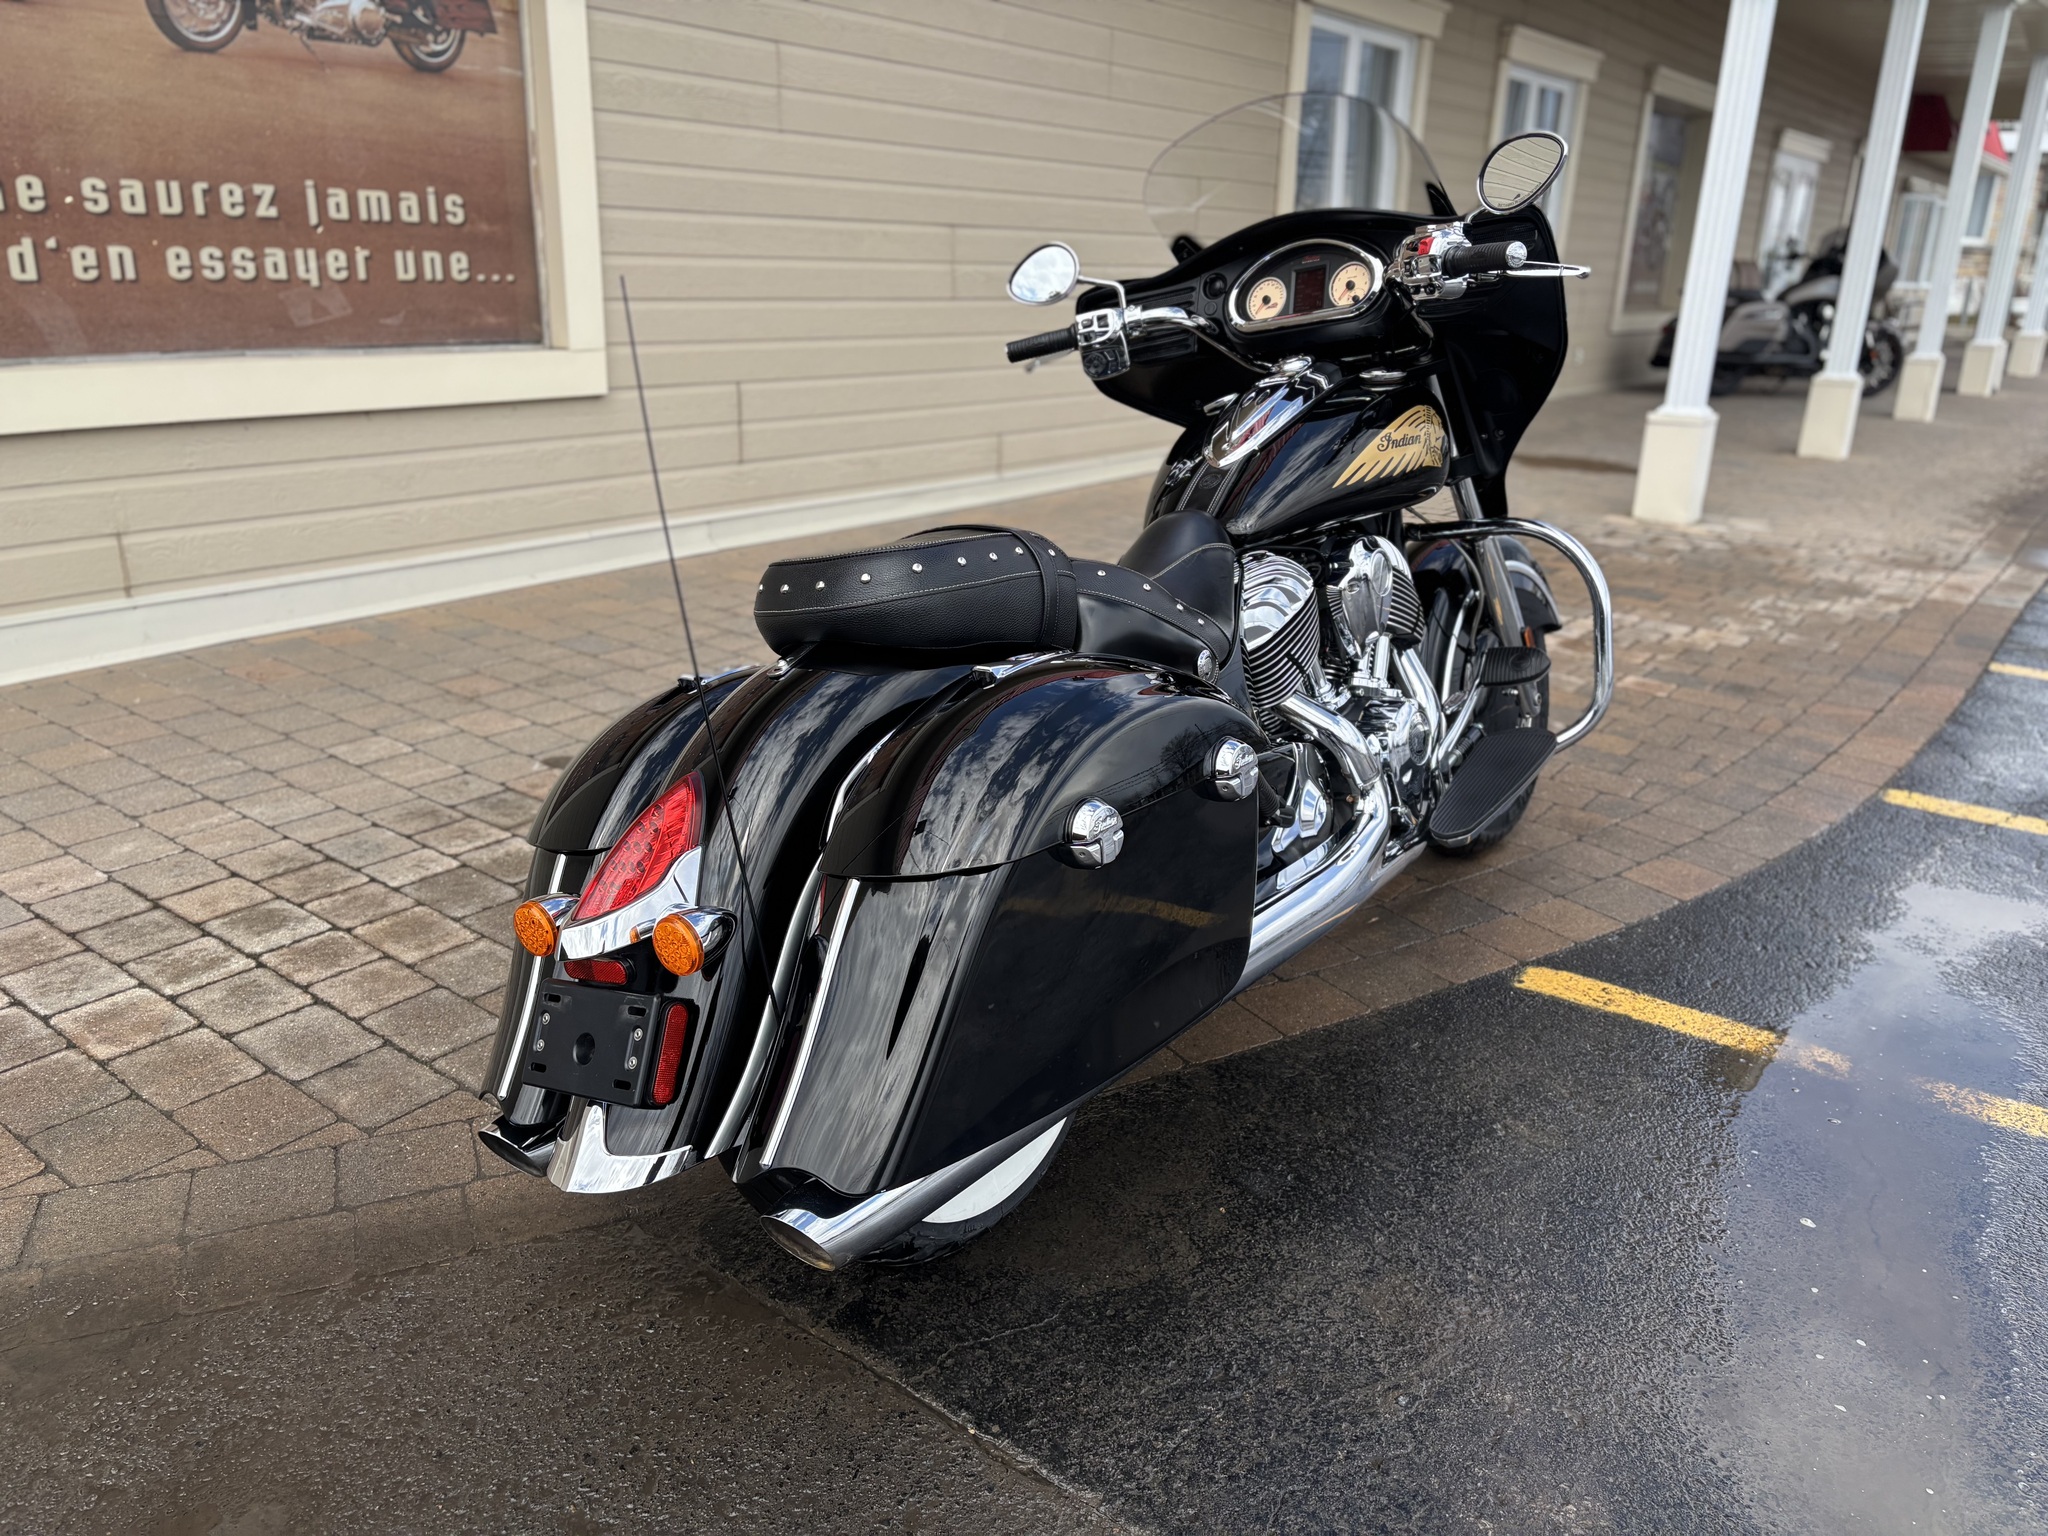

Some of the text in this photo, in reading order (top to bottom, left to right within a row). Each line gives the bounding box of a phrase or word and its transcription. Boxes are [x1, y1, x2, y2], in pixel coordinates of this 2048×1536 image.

[0, 174, 466, 226] e saurez jamais
[6, 236, 515, 287] d'en essayer une...
[1377, 432, 1422, 452] Indian
